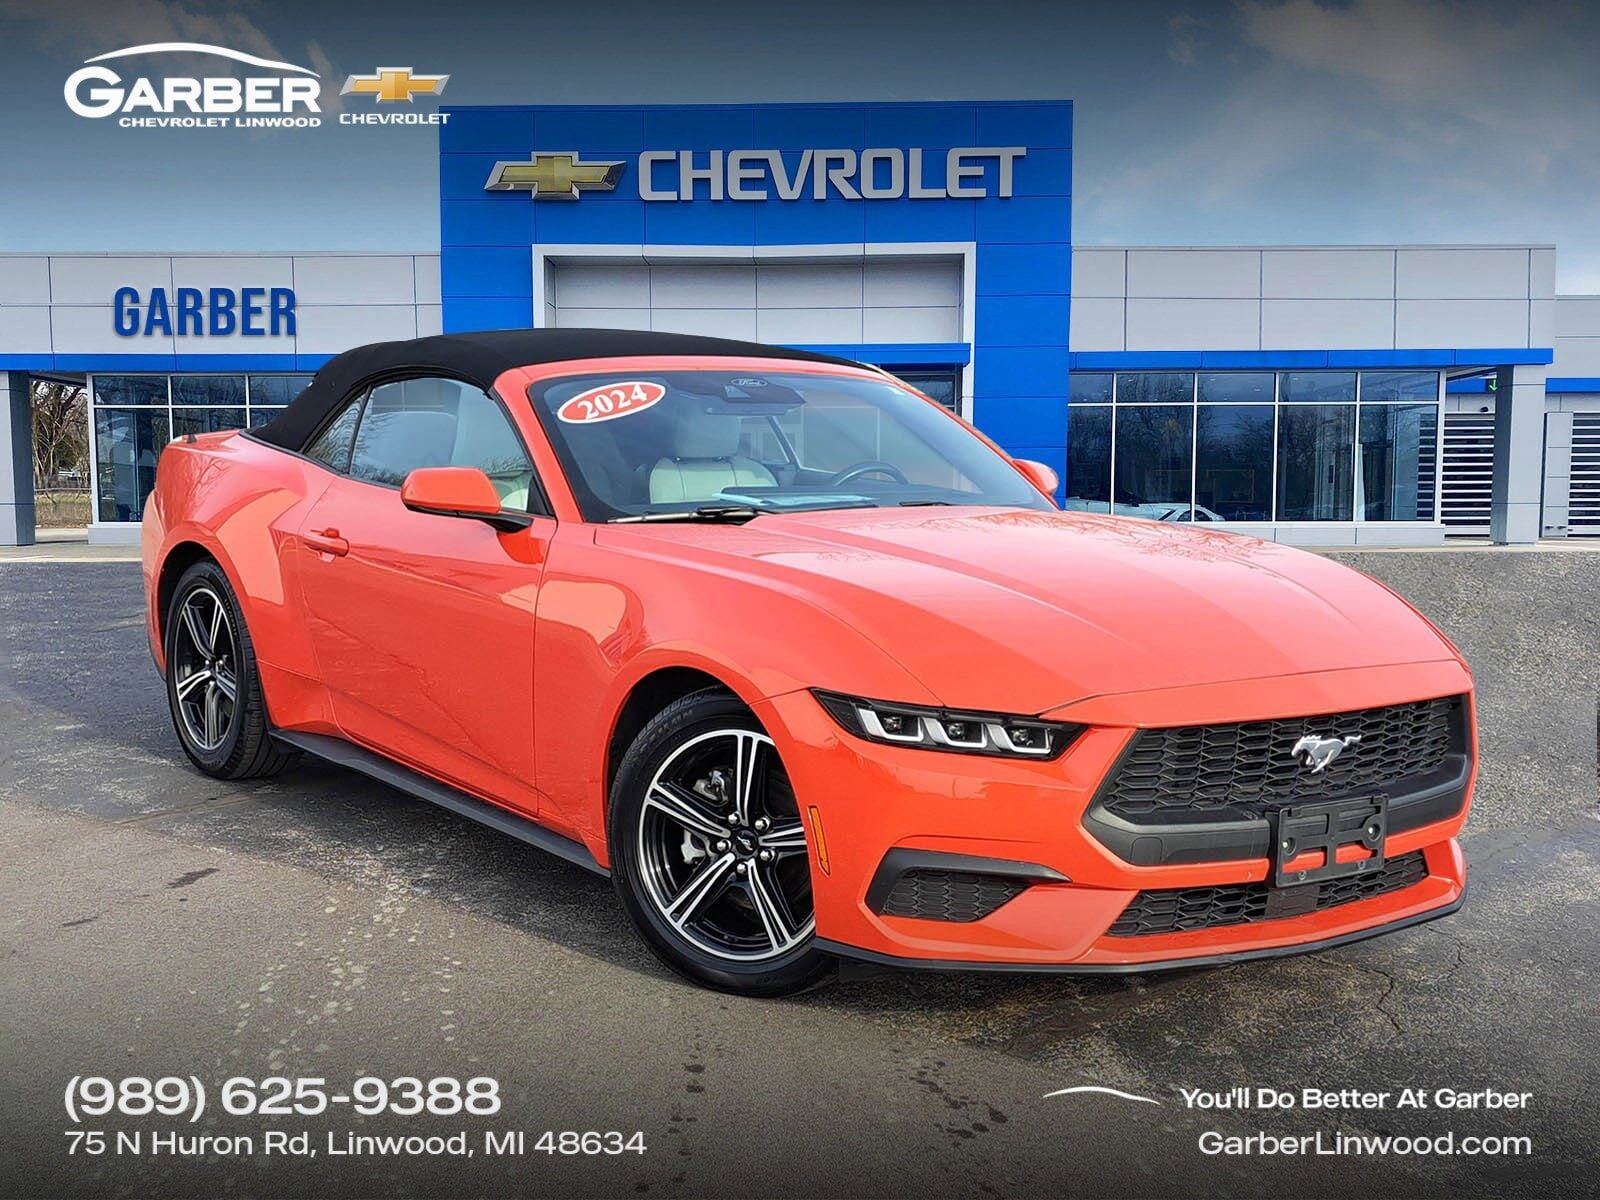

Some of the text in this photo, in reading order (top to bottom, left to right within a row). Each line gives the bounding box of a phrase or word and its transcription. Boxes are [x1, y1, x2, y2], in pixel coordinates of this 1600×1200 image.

[638, 146, 1027, 201] CHEVROLET
[114, 286, 297, 337] GARBER
[577, 384, 648, 420] 2024
